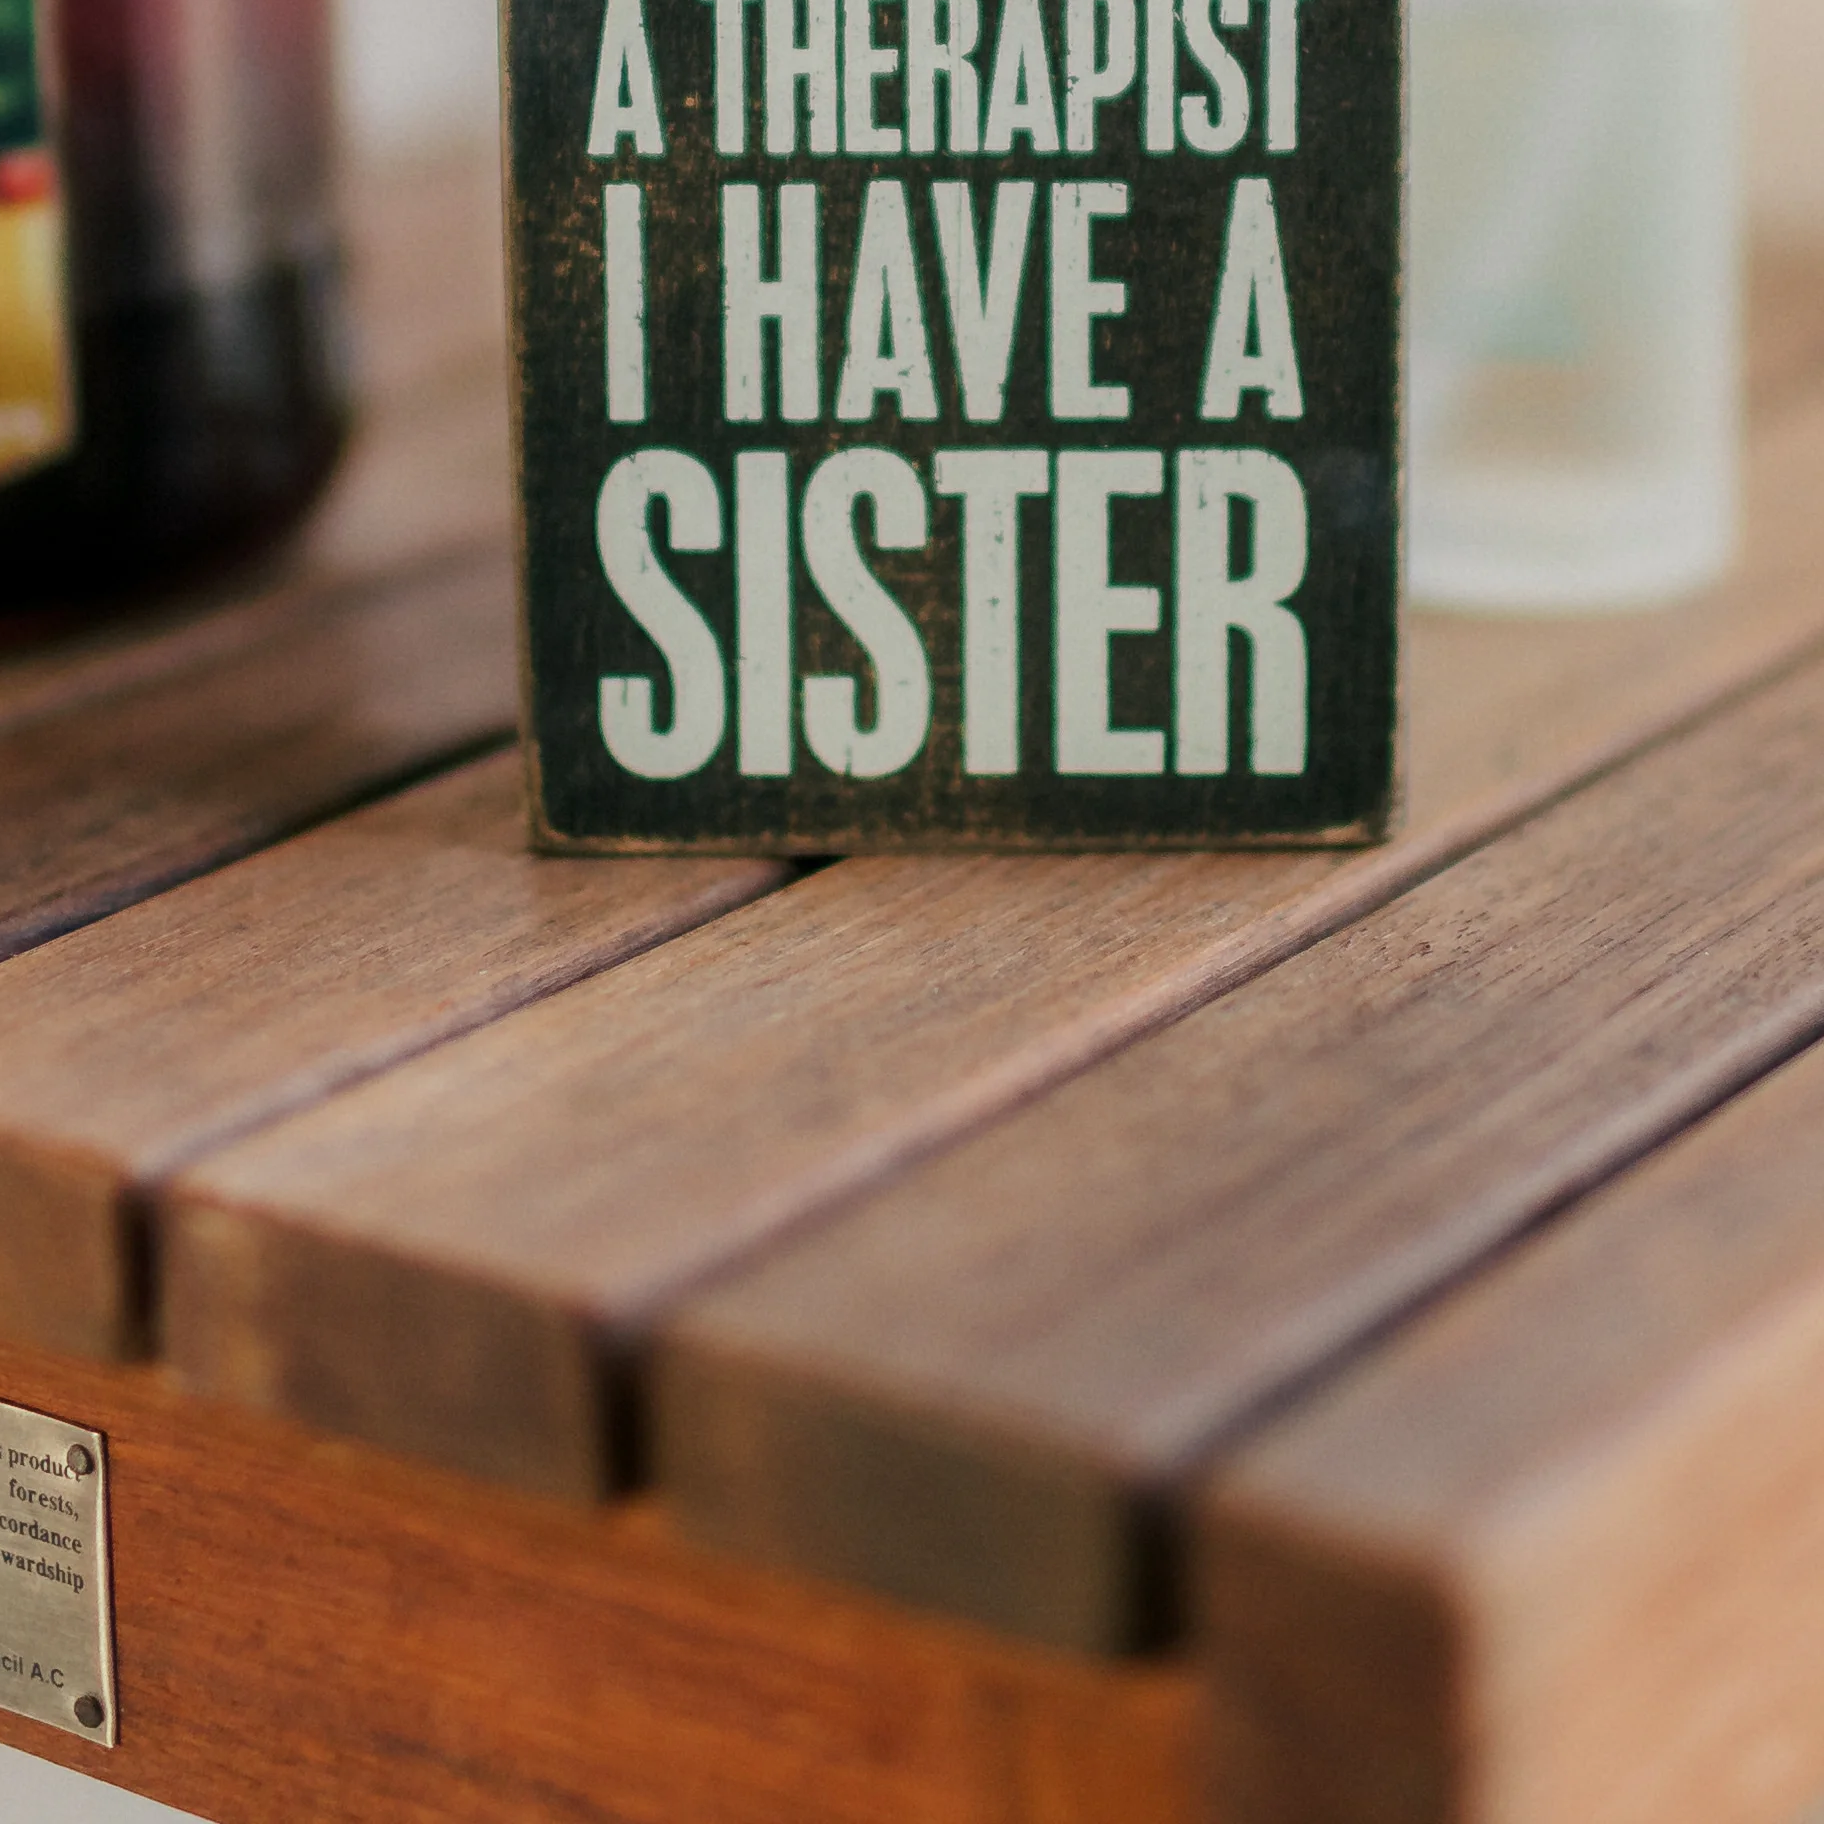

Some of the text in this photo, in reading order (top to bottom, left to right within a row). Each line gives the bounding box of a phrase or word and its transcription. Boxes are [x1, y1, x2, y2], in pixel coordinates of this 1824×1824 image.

[605, 178, 1305, 422] I HAVE A
[596, 447, 1309, 779] SISTER
[8, 1446, 81, 1482] produc
[9, 1478, 80, 1522] forests,
[30, 1661, 65, 1689] A.C
